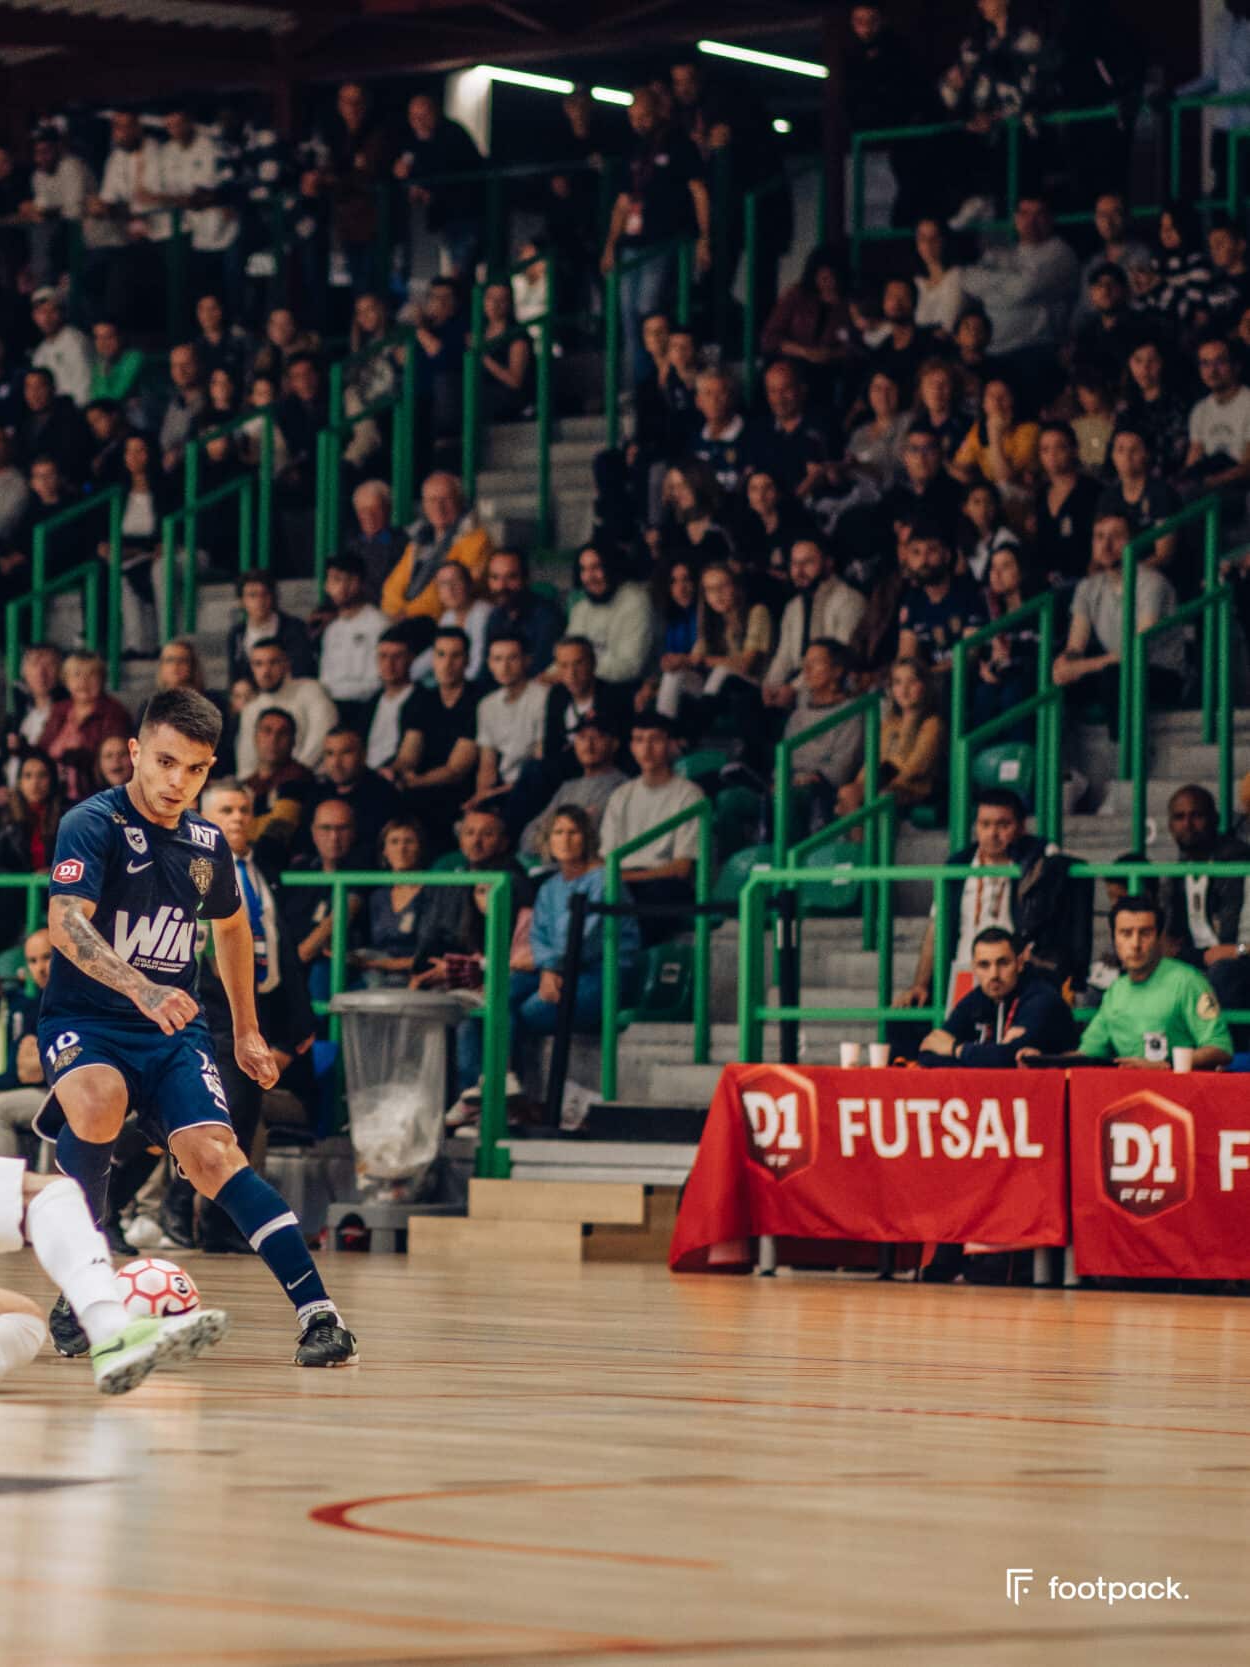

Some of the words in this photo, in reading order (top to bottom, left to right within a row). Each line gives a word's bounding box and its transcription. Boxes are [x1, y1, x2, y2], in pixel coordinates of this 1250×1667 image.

[59, 864, 78, 876] D1
[46, 1031, 80, 1065] 10
[742, 1091, 802, 1150] D1
[837, 1098, 1045, 1159] FUTSAL
[1109, 1121, 1178, 1184] D1
[1218, 1129, 1250, 1192] F
[1120, 1187, 1166, 1203] FFF
